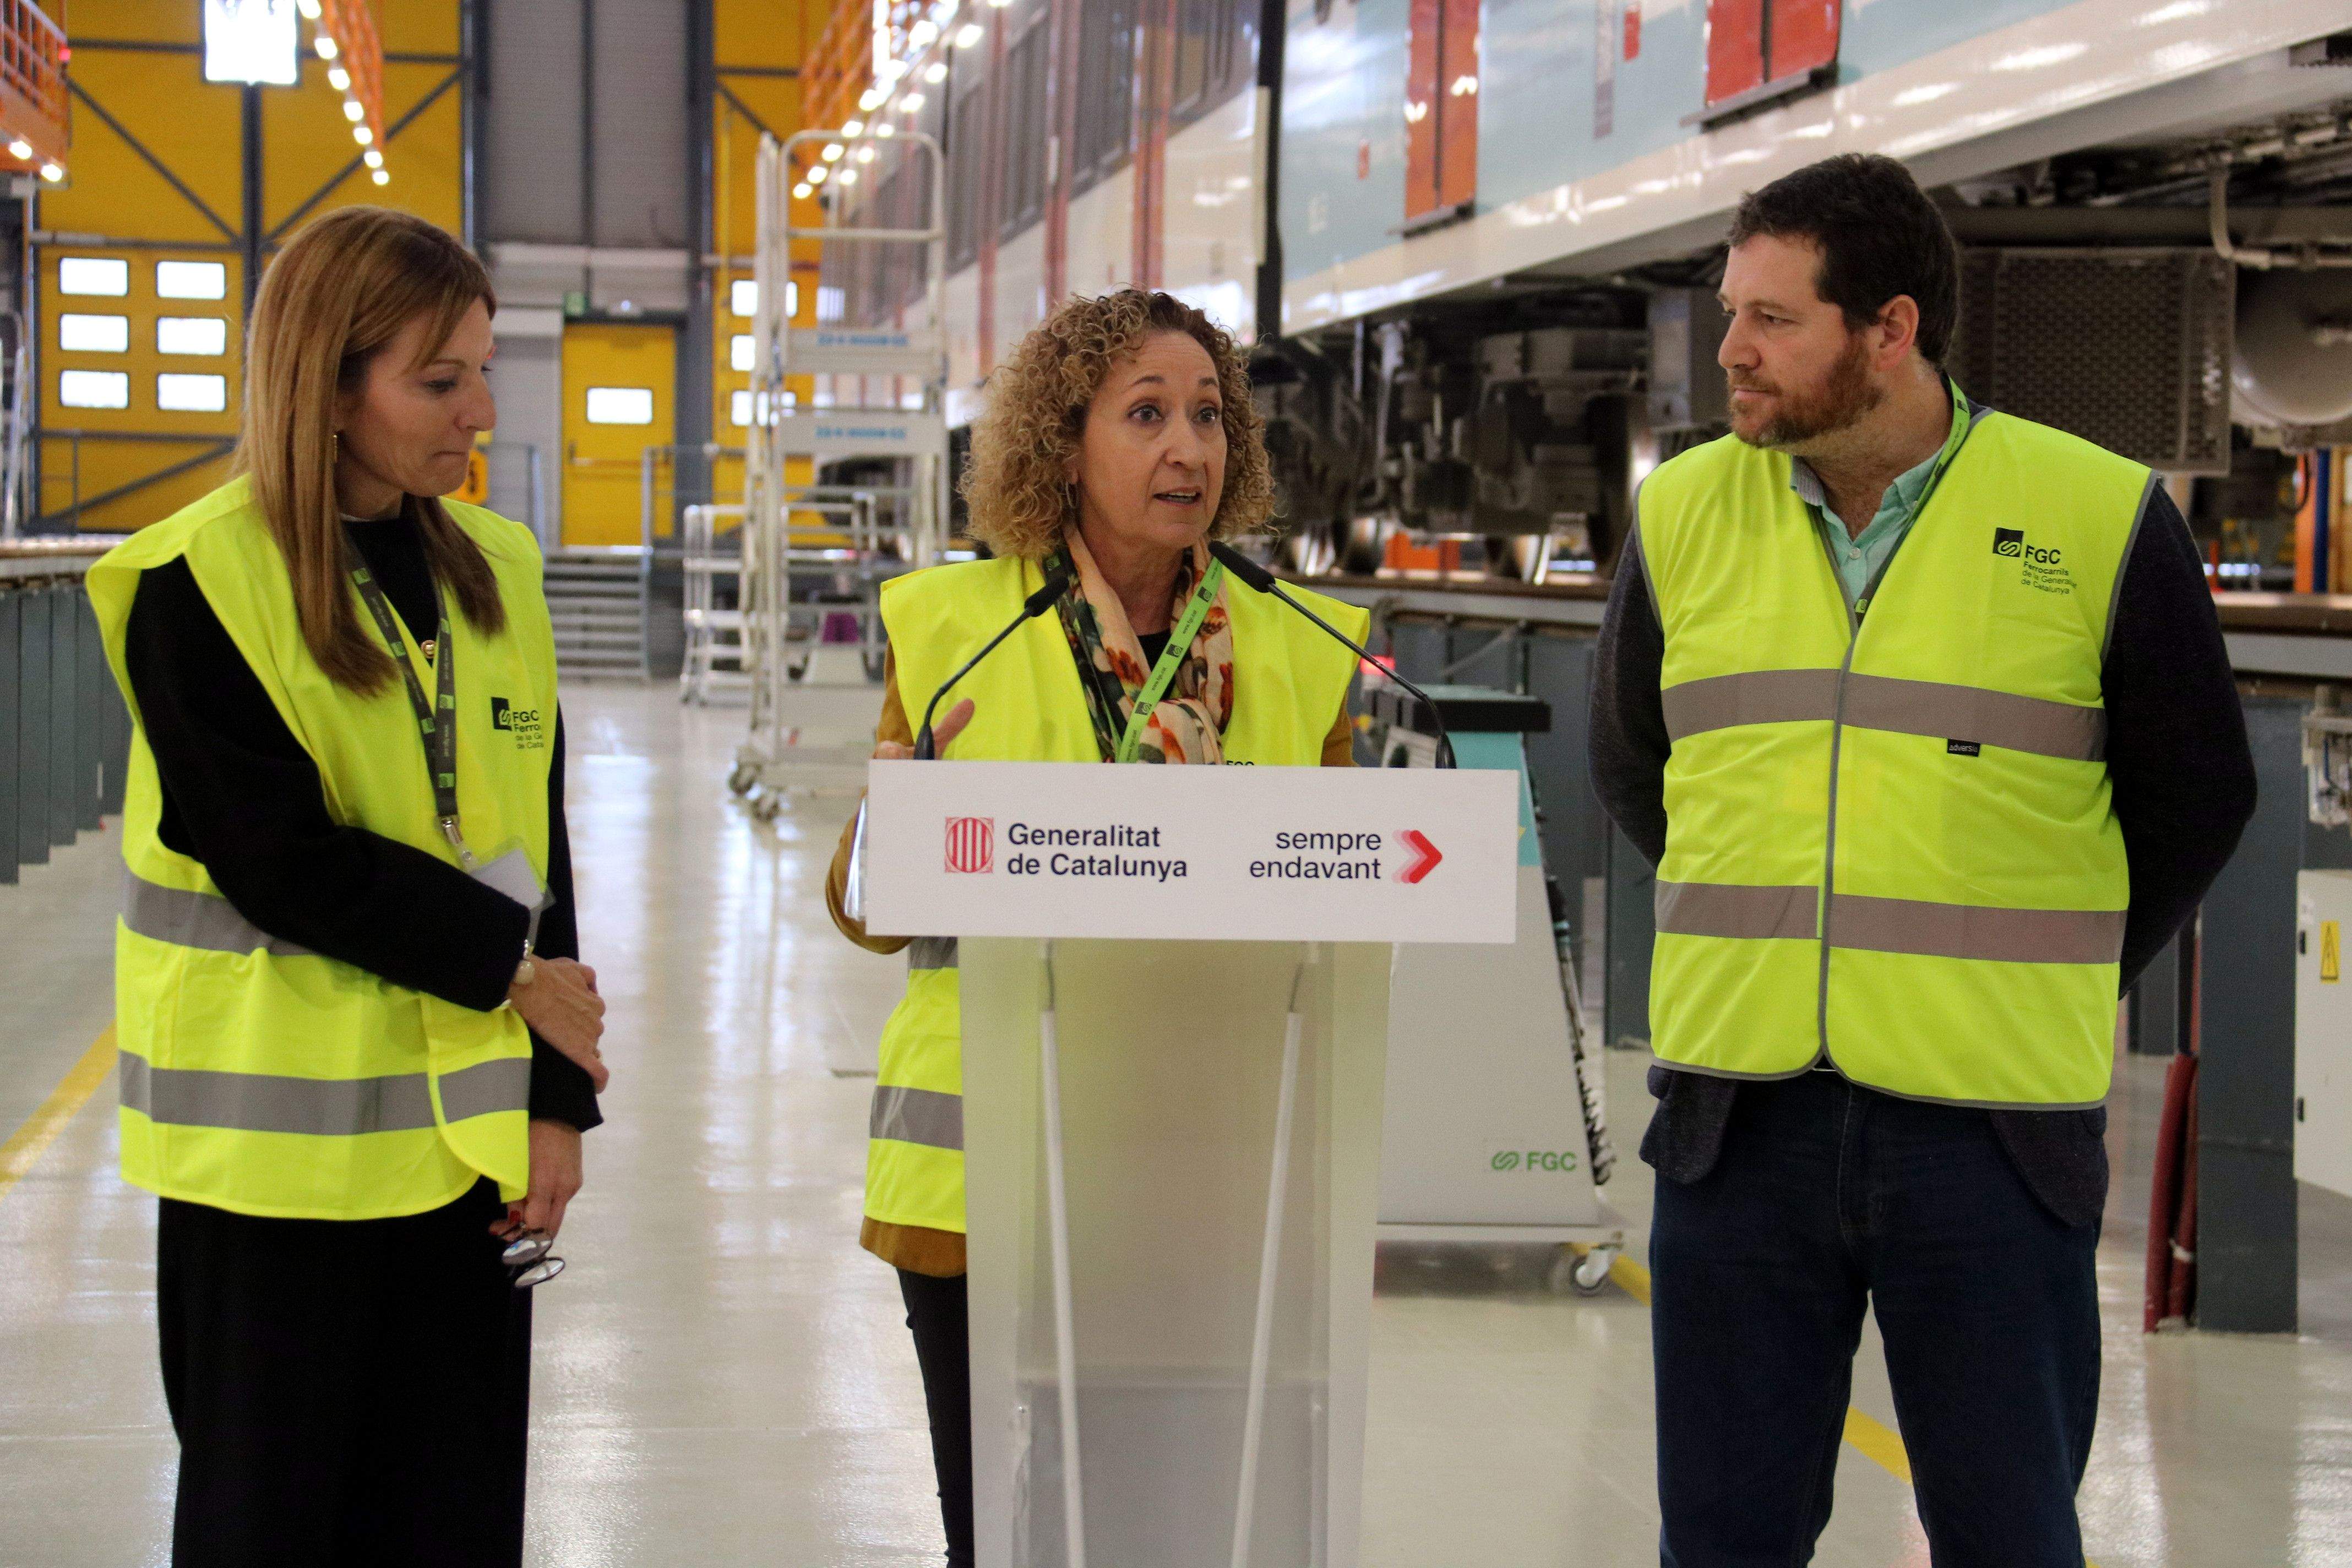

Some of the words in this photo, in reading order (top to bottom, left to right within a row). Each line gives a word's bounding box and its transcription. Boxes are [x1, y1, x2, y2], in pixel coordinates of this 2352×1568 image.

[2026, 545, 2061, 564] FGC
[2023, 561, 2069, 575] Ferrocarrils
[513, 710, 539, 722] FGC
[1008, 823, 1161, 847] Generalitat
[1276, 831, 1381, 855] sempre
[1008, 853, 1040, 874] de
[1050, 853, 1187, 882] Catalunya
[1249, 856, 1381, 879] endavant
[1527, 1151, 1576, 1171] FGC
